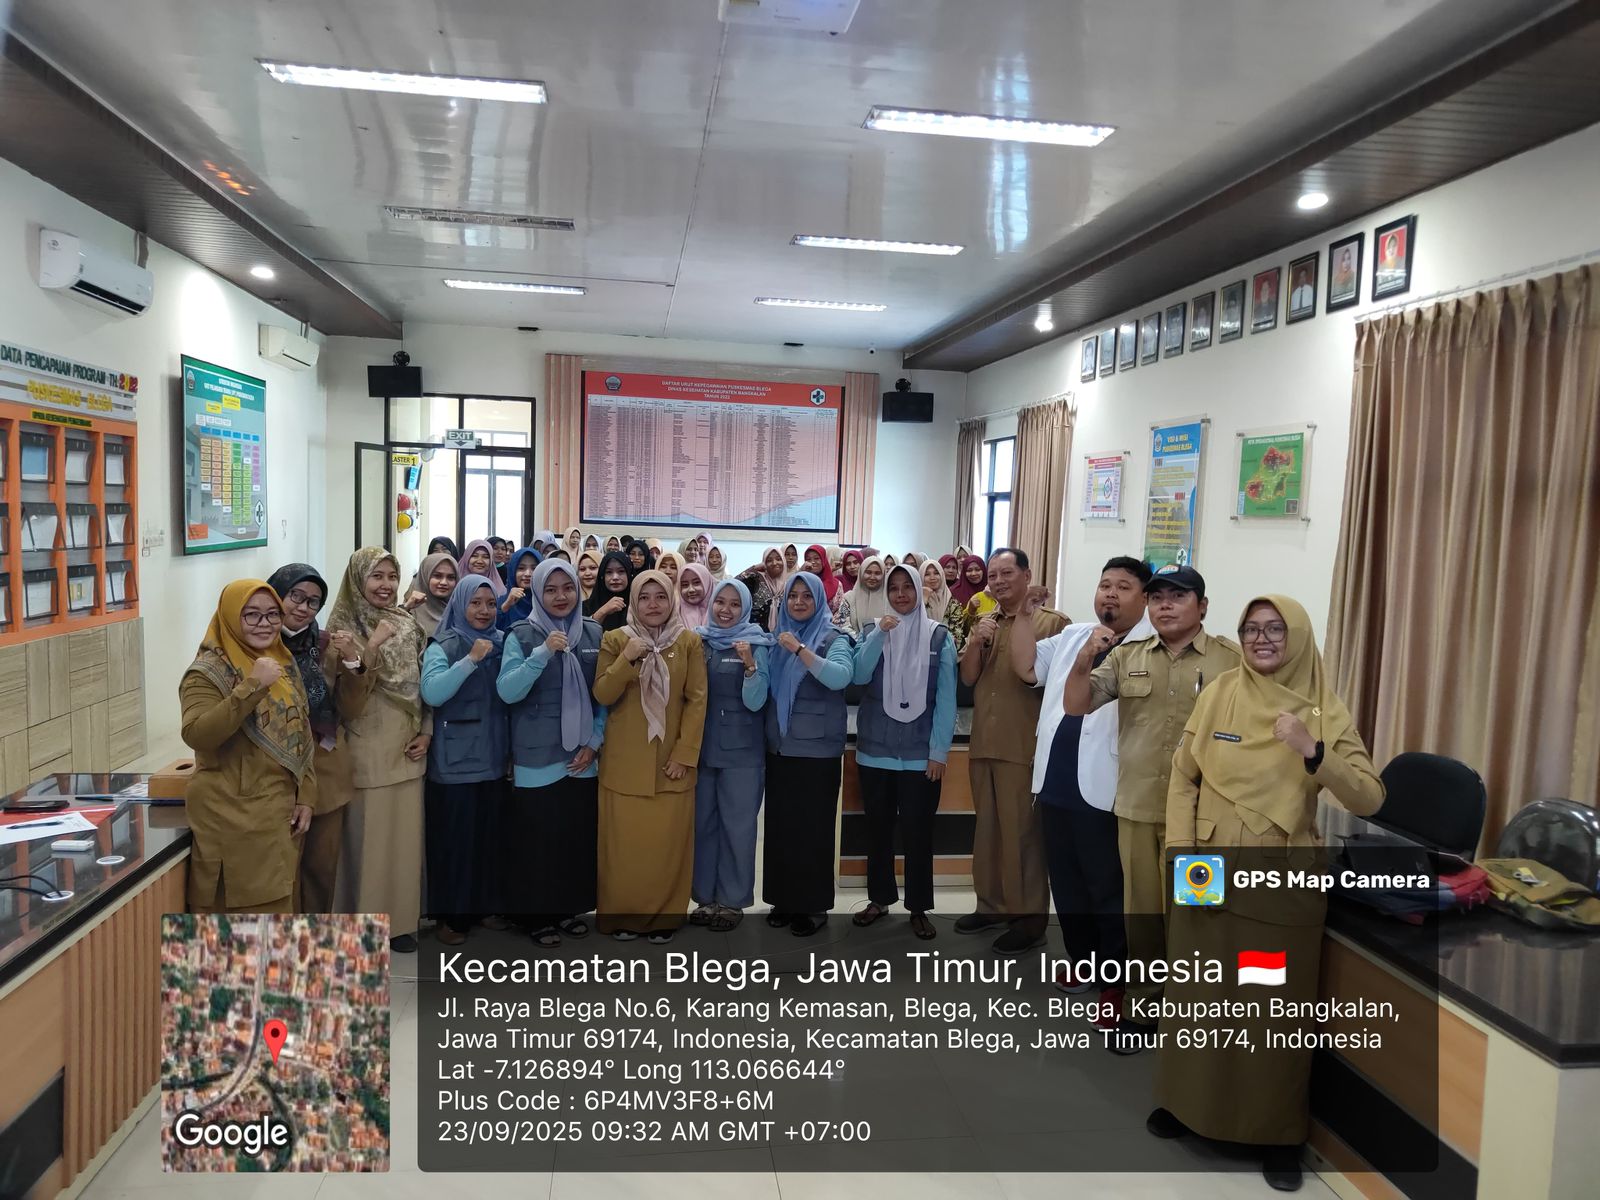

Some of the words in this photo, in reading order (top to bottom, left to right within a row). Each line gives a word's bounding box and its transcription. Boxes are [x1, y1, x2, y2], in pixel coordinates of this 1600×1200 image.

[1, 344, 23, 365] DATA
[72, 364, 106, 385] PROGRAM
[449, 431, 472, 440] EXIT
